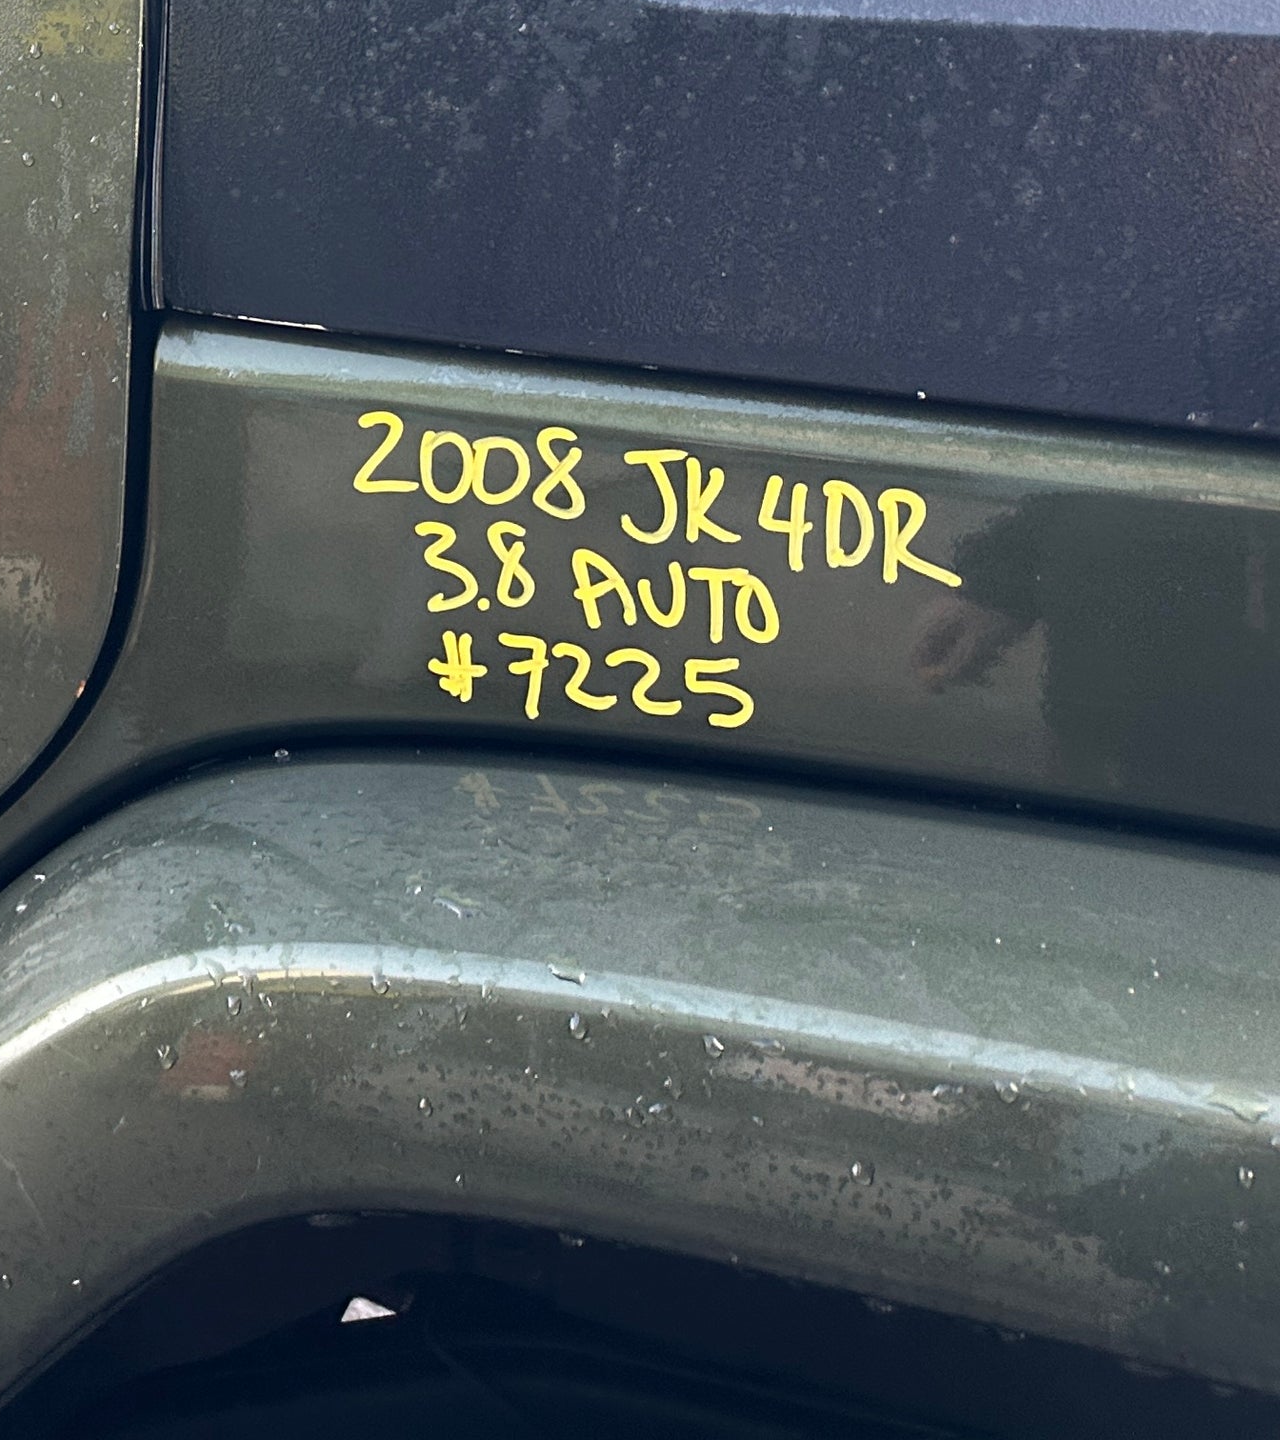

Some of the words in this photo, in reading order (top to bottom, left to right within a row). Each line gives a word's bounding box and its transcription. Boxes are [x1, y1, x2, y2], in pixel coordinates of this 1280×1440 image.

[352, 410, 585, 519] 2008
[620, 449, 741, 545] JK
[757, 475, 962, 586] 4DR
[414, 520, 535, 613] 3.8
[571, 547, 780, 644] AUTO
[427, 630, 755, 728] #7225
